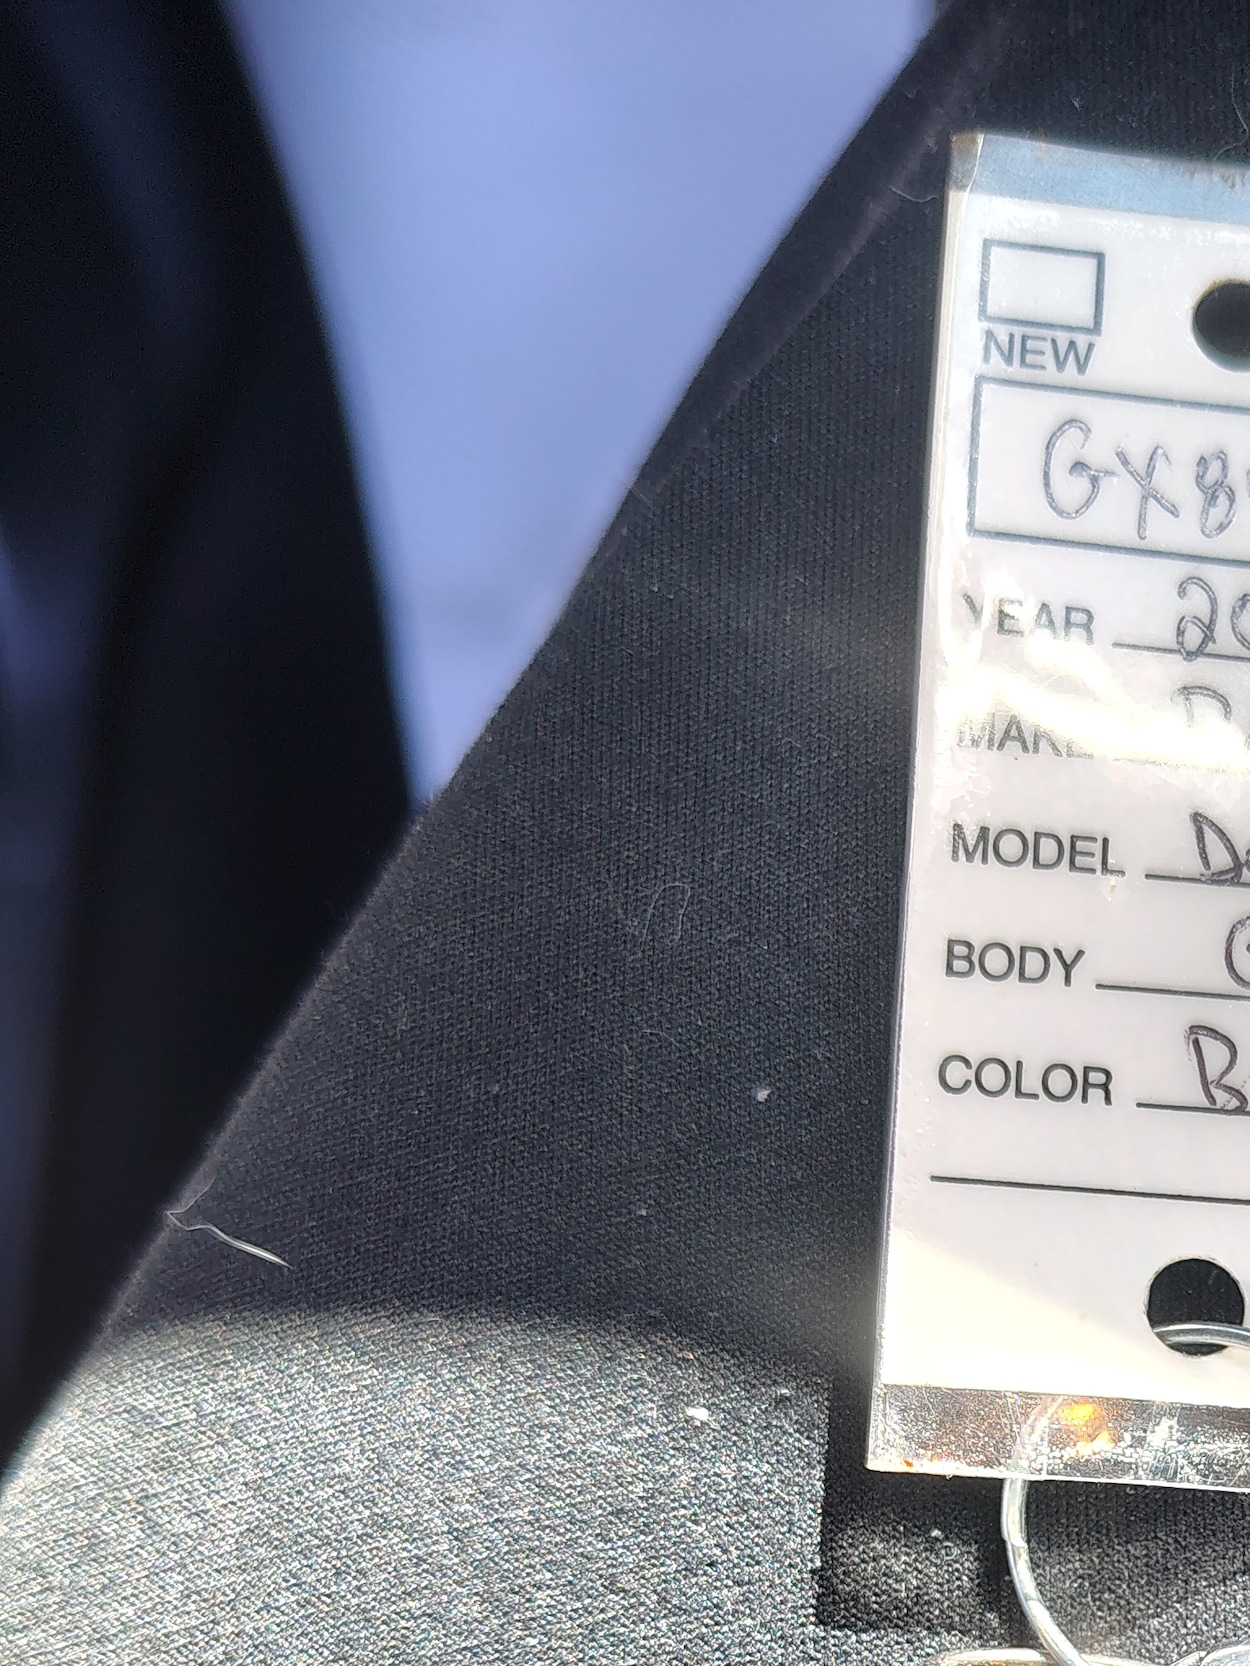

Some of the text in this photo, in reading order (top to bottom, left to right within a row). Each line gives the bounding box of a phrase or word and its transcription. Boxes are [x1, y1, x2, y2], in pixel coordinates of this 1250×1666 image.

[983, 331, 1095, 376] NEW
[962, 592, 1096, 647] YEAR
[955, 713, 1096, 760] MAK
[950, 823, 1127, 879] MODEL
[944, 938, 1087, 989] BODY
[937, 1054, 1114, 1107] COLOR
